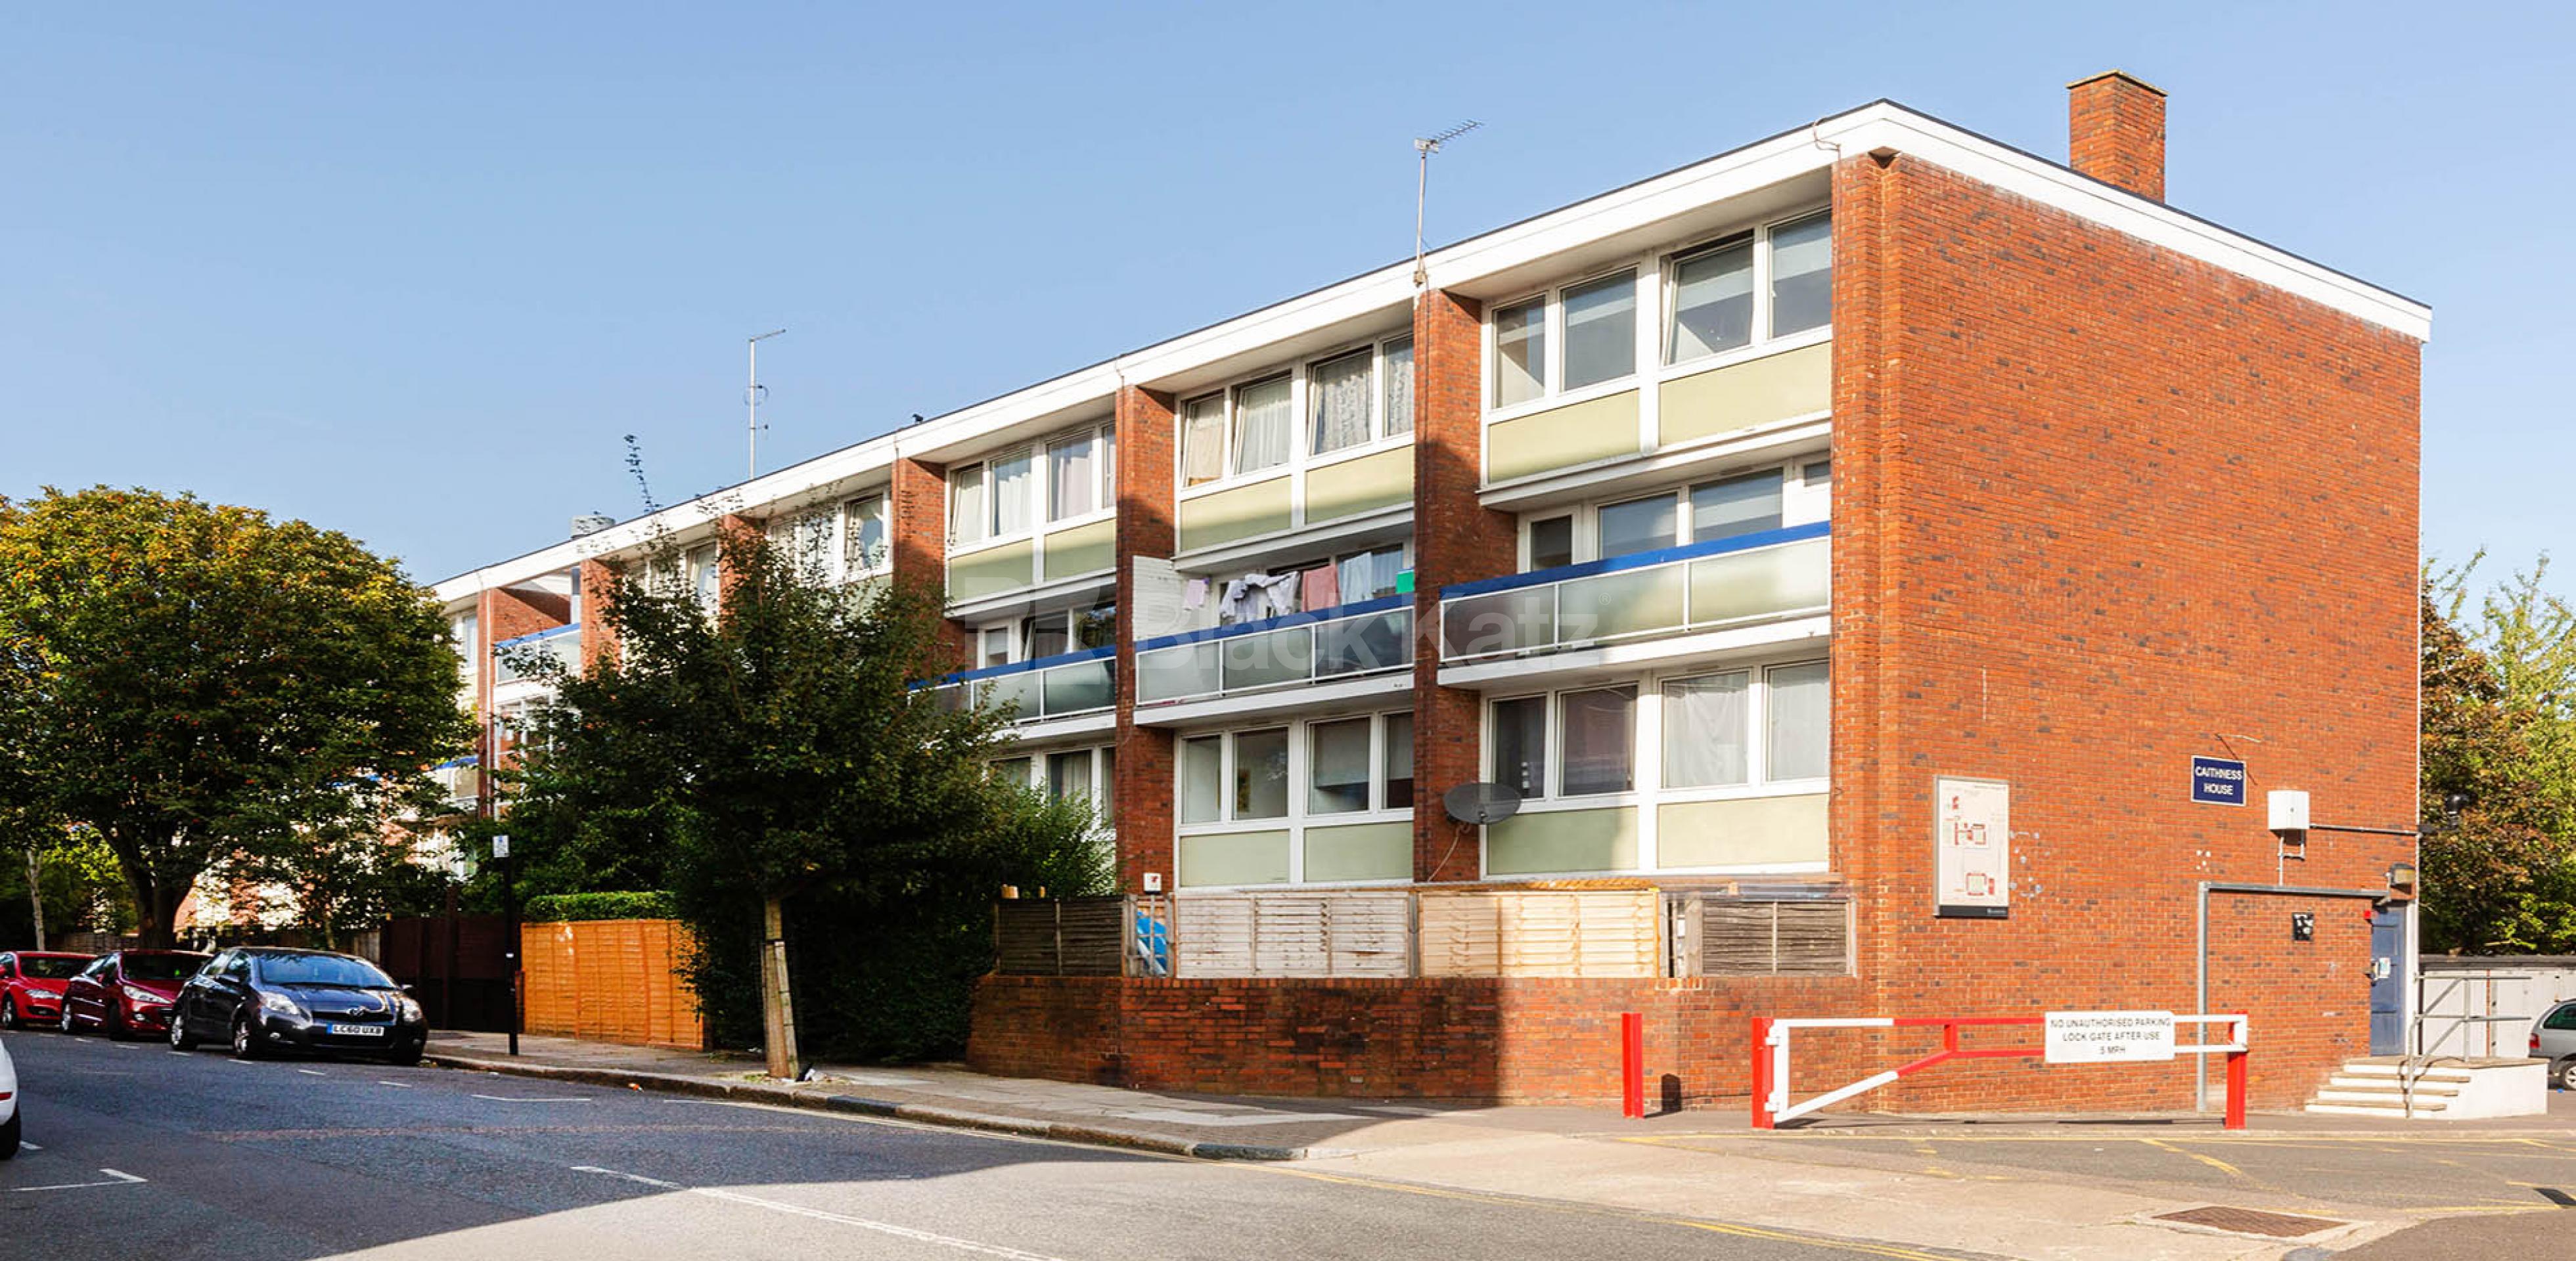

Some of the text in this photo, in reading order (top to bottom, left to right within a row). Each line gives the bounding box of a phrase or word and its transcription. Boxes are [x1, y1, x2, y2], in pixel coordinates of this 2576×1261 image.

[2196, 766, 2242, 780] CAITHNESS
[2203, 783, 2233, 795] HOUSE
[2050, 1017, 2171, 1028] NO UNAUTHORISED PARKING
[2063, 1031, 2160, 1042] LOCK GATE AFTER USE
[2107, 1046, 2126, 1054] MPH
